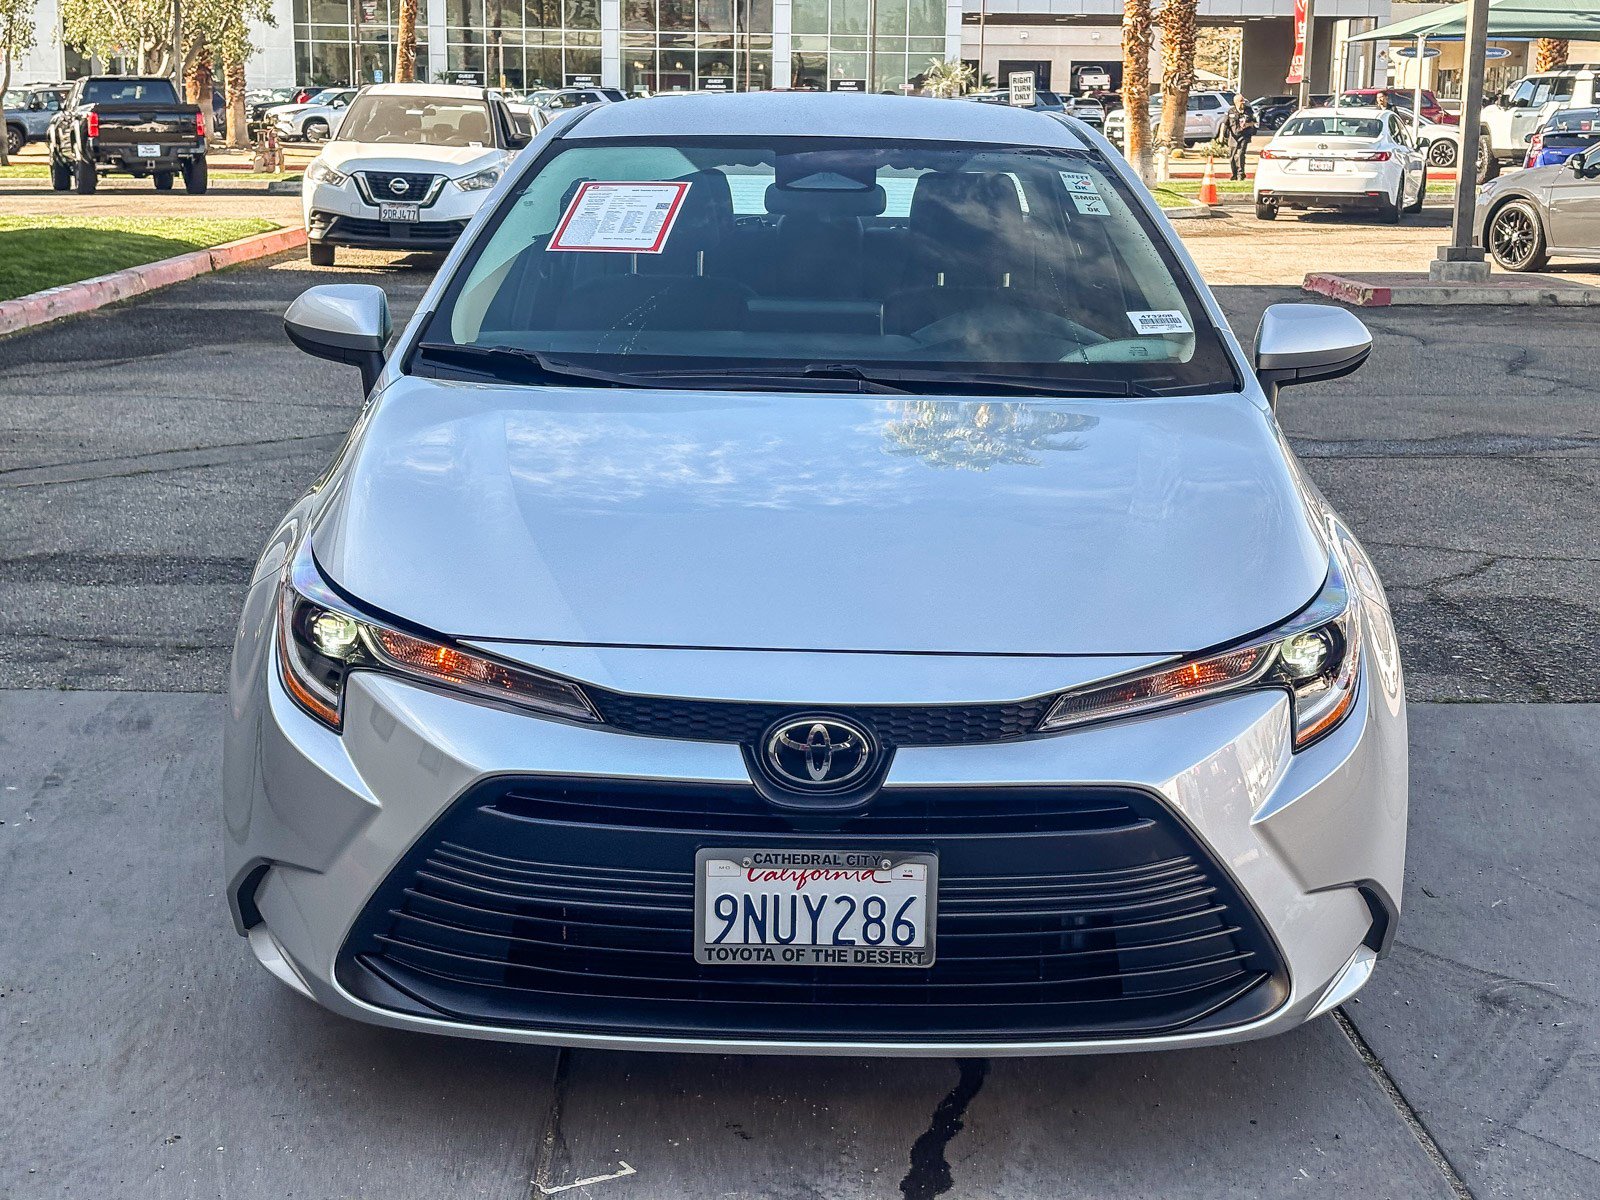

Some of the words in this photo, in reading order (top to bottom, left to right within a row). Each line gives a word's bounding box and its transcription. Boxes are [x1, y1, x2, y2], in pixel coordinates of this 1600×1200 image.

[382, 209, 416, 220] 9DRJ477
[753, 852, 842, 866] CATHEDRAL
[846, 854, 882, 867] CITY
[747, 868, 892, 890] California
[712, 894, 918, 946] 9NUY286
[704, 948, 776, 962] TOYOTA
[782, 948, 806, 962] OF
[812, 949, 848, 963] THE
[854, 950, 926, 965] DESERT
